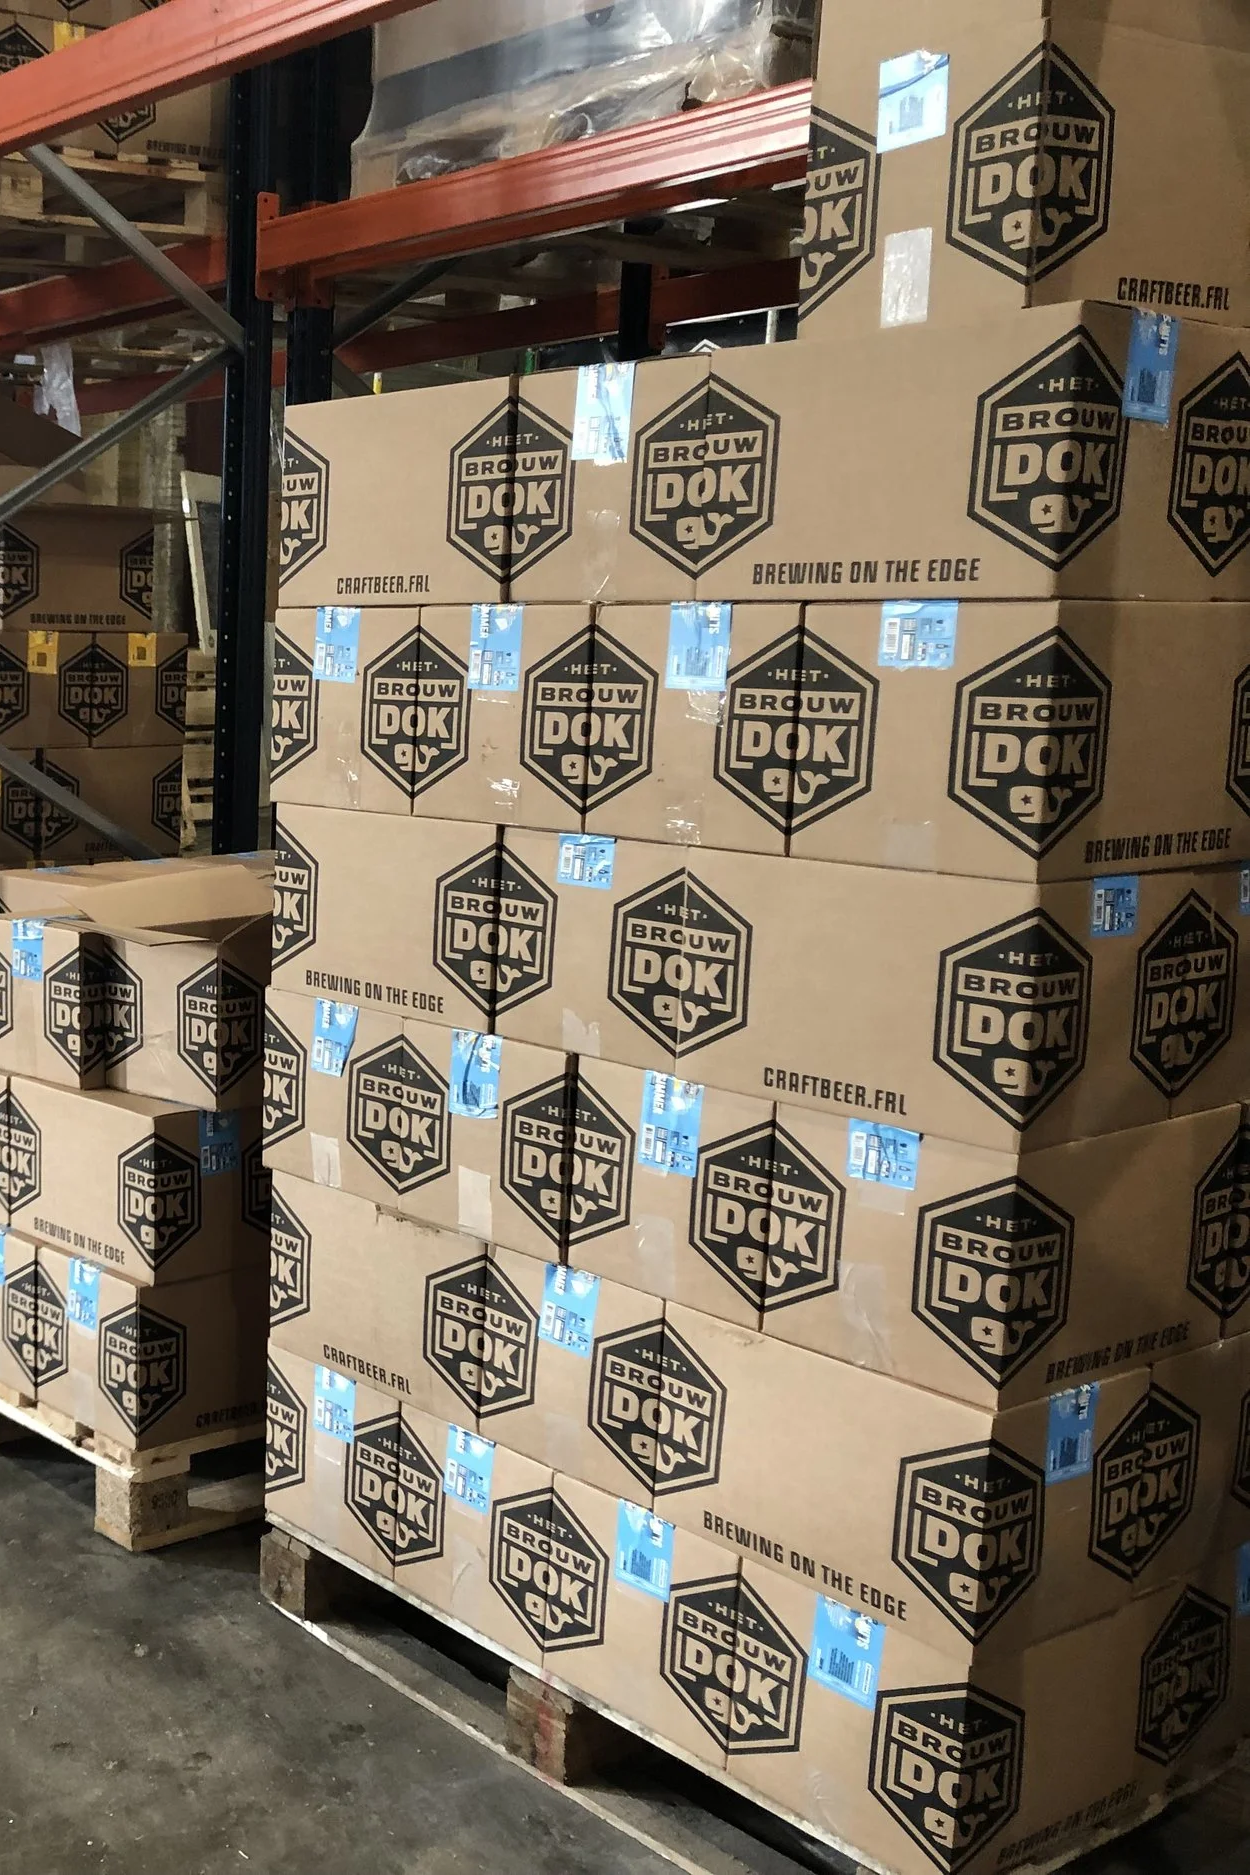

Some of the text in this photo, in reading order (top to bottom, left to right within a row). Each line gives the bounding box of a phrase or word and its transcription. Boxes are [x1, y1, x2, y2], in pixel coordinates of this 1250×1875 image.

[975, 123, 1095, 154] BROUW
[978, 153, 1087, 207] DOK
[1117, 276, 1231, 311] CRAFTBEER.FRL
[1002, 407, 1115, 431] BROUW
[1192, 423, 1250, 444] BROU
[465, 454, 558, 476] BROUW
[653, 436, 758, 463] BROUW
[1003, 440, 1108, 486] DOK
[468, 480, 551, 518] DOK
[656, 464, 749, 508] DOK
[337, 575, 430, 594] CRAFTBEER.FRL
[753, 558, 980, 584] BREWING ON THE EDGE
[377, 682, 456, 698] BROUW
[541, 688, 638, 704] BROUW
[739, 694, 855, 713] BROUW
[379, 705, 450, 738] DOK
[543, 712, 630, 748] DOK
[980, 703, 1095, 721] BROUW
[742, 721, 847, 763] DOK
[983, 733, 1089, 776] DOK
[1085, 828, 1232, 864] BREWING ON THE EDGE
[451, 896, 539, 921] BROUW
[454, 919, 534, 962] DOK
[631, 923, 731, 953] BROUW
[633, 949, 724, 999] DOK
[964, 974, 1076, 998] BROUW
[1149, 954, 1224, 982] BROUW
[306, 970, 444, 1014] BREWING ON THE EDGE
[1150, 981, 1218, 1030] DOK
[191, 1020, 247, 1047] DOK
[966, 1002, 1070, 1051] DOK
[363, 1079, 438, 1109] BROUW
[764, 1067, 907, 1116] CRAFTBEER.FRL
[365, 1101, 432, 1147] DOK
[519, 1123, 617, 1155] BROUW
[128, 1171, 189, 1189] BROUW
[522, 1146, 611, 1196] DOK
[713, 1171, 822, 1212] BROUW
[130, 1192, 184, 1222] DOK
[33, 1217, 125, 1265] BREWING ON THE EDGE
[716, 1200, 812, 1257] DOK
[942, 1232, 1056, 1263] BROUW
[945, 1264, 1049, 1313] DOK
[13, 1311, 58, 1348] DOK
[440, 1296, 523, 1338] BROUW
[109, 1336, 173, 1355] BROUW
[443, 1320, 515, 1373] DOK
[110, 1357, 170, 1387] DOK
[323, 1345, 412, 1395] CRAFTBEER.FRL
[610, 1359, 707, 1408] BROUW
[612, 1388, 700, 1450] DOK
[360, 1450, 432, 1492] BROUW
[363, 1475, 426, 1529] DOK
[922, 1486, 1031, 1524] BROUW
[1110, 1463, 1181, 1525] DOK
[507, 1522, 591, 1574] BROUW
[925, 1514, 1022, 1570] DOK
[510, 1550, 585, 1612] DOK
[703, 1510, 783, 1564] BREWING
[791, 1554, 815, 1579] ON
[822, 1564, 853, 1596] THE
[861, 1582, 907, 1621] EDGE
[683, 1611, 785, 1671] BROUW
[685, 1641, 777, 1713] DOK
[898, 1720, 1008, 1766] BROUW
[900, 1749, 1000, 1809] DOK
